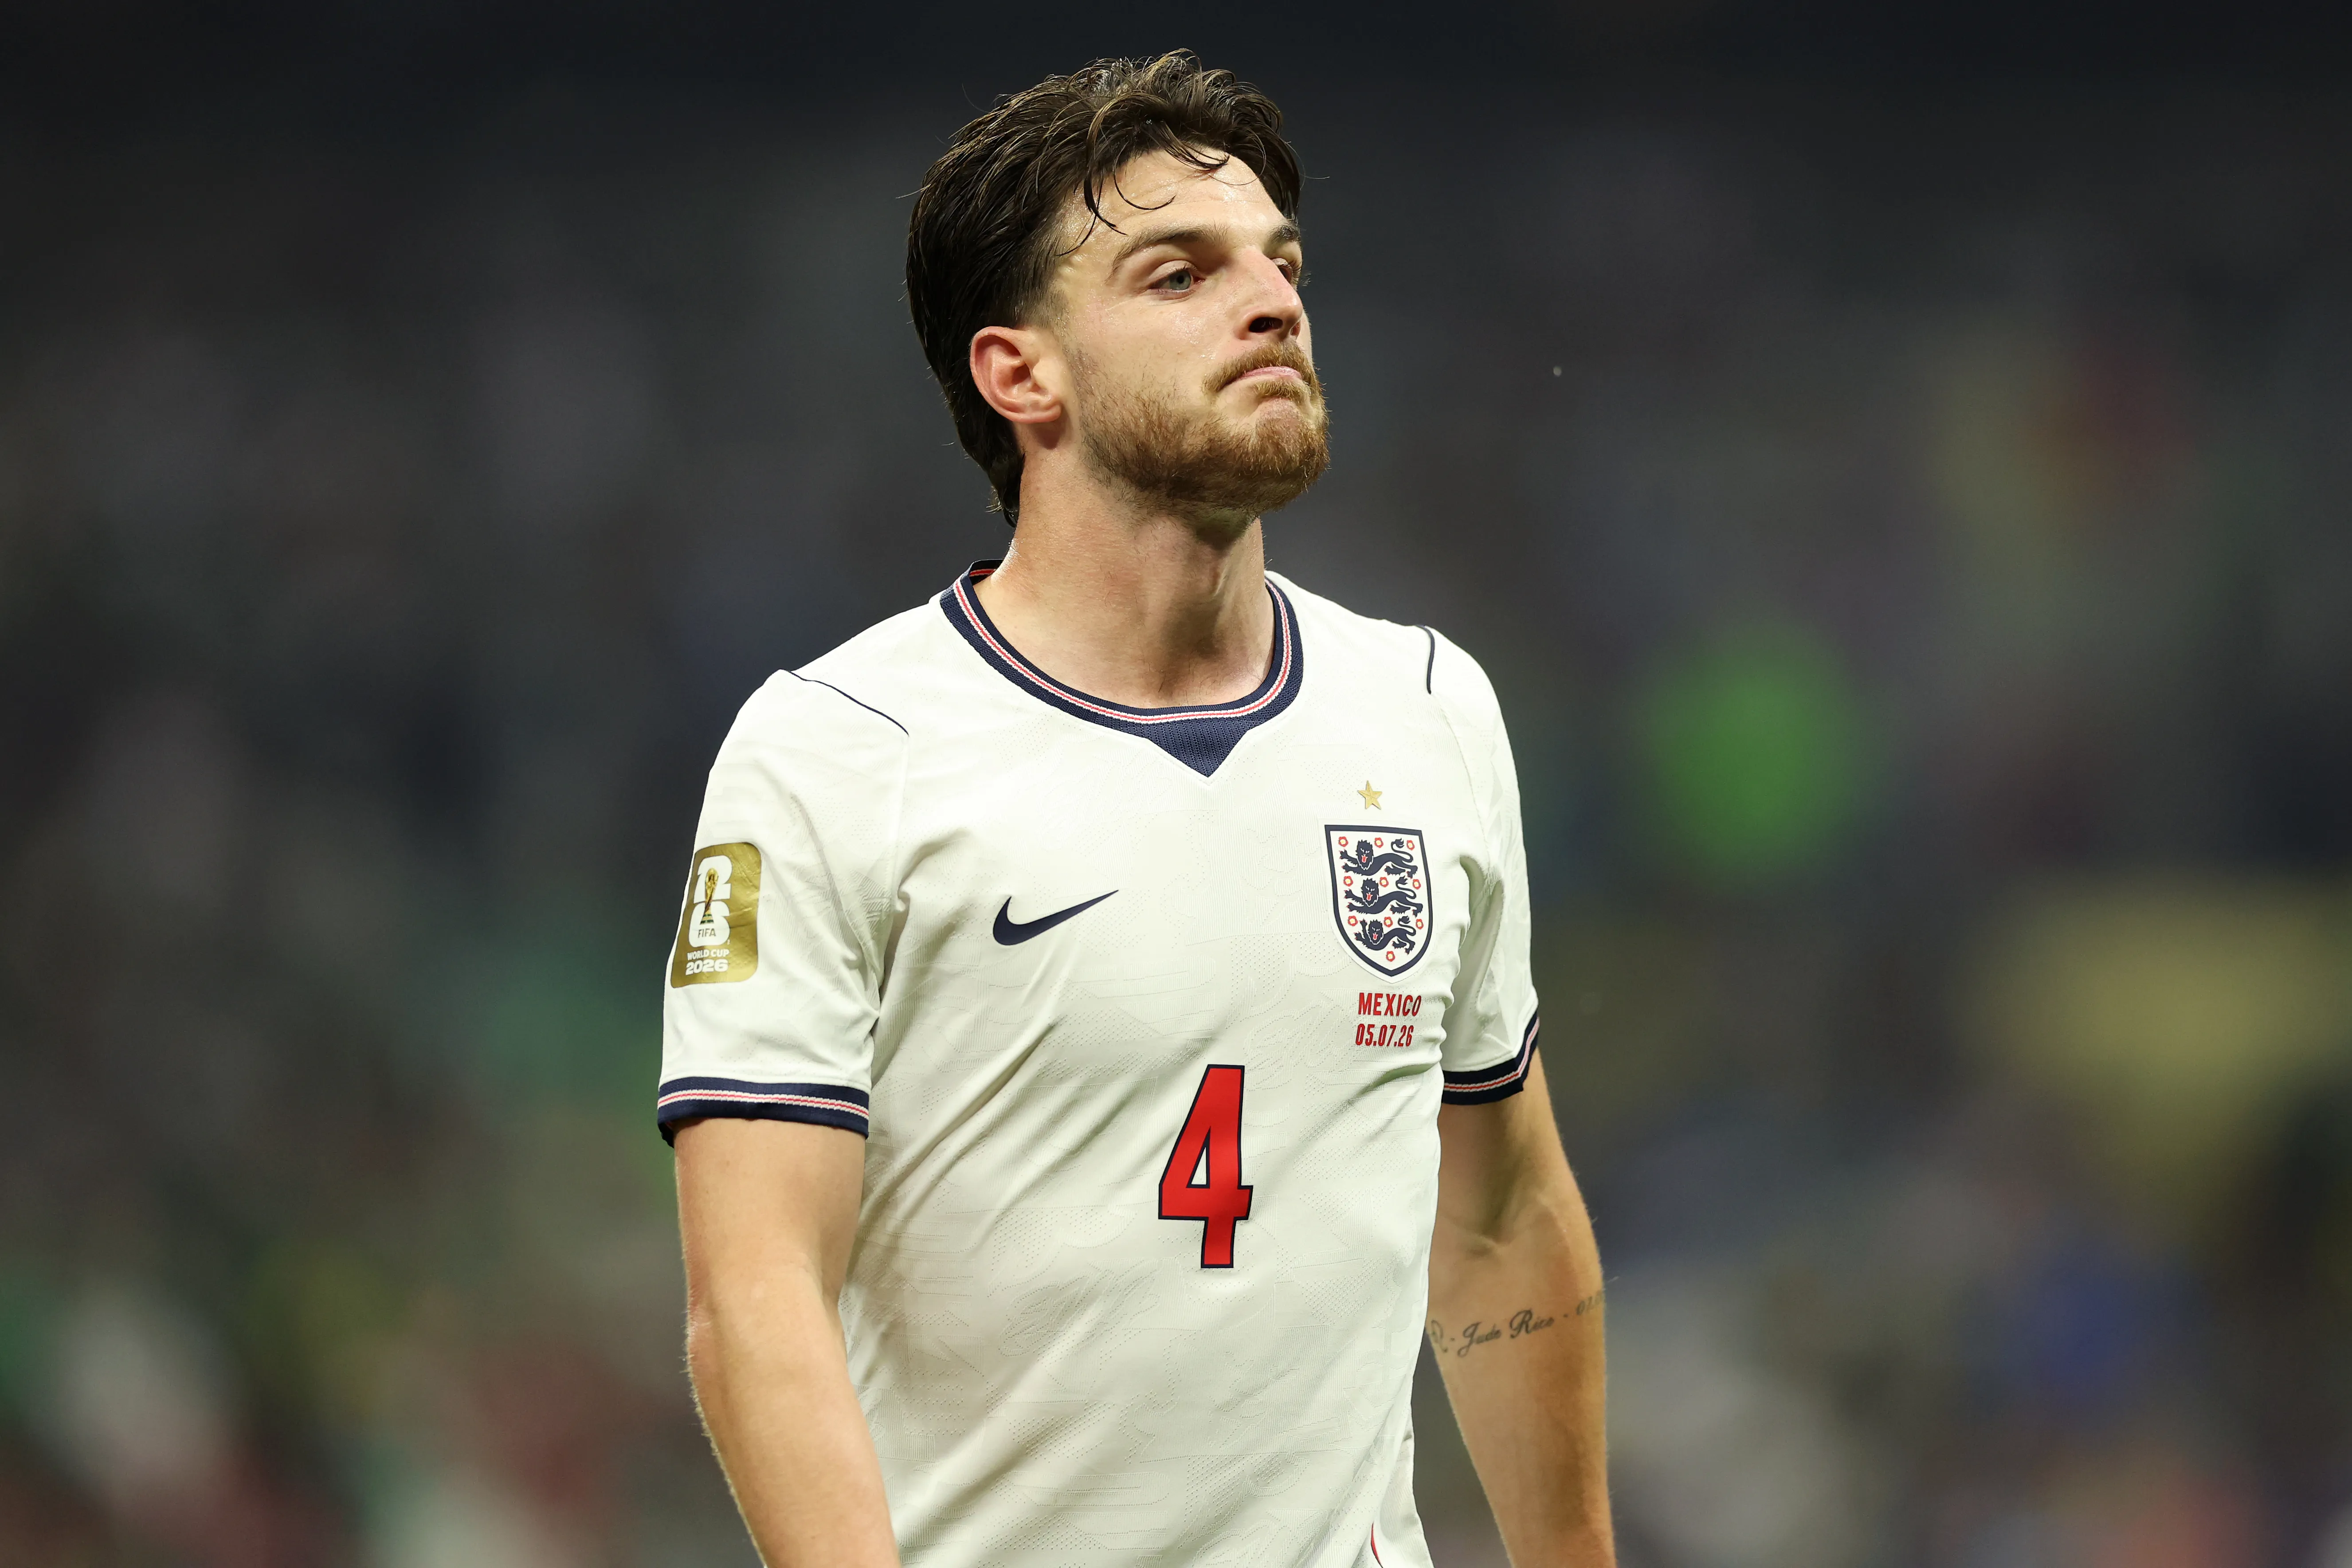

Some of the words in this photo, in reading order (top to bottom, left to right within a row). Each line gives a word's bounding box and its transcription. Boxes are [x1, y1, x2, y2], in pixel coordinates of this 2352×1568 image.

[698, 928, 716, 938] FIFA
[686, 959, 729, 975] 2026
[687, 949, 710, 961] WORLD
[710, 949, 729, 957] CUP
[1358, 992, 1422, 1016] MEXICO
[1355, 1023, 1414, 1047] 05.07.26
[1158, 1064, 1254, 1269] 4
[1509, 1308, 1555, 1339] Rice
